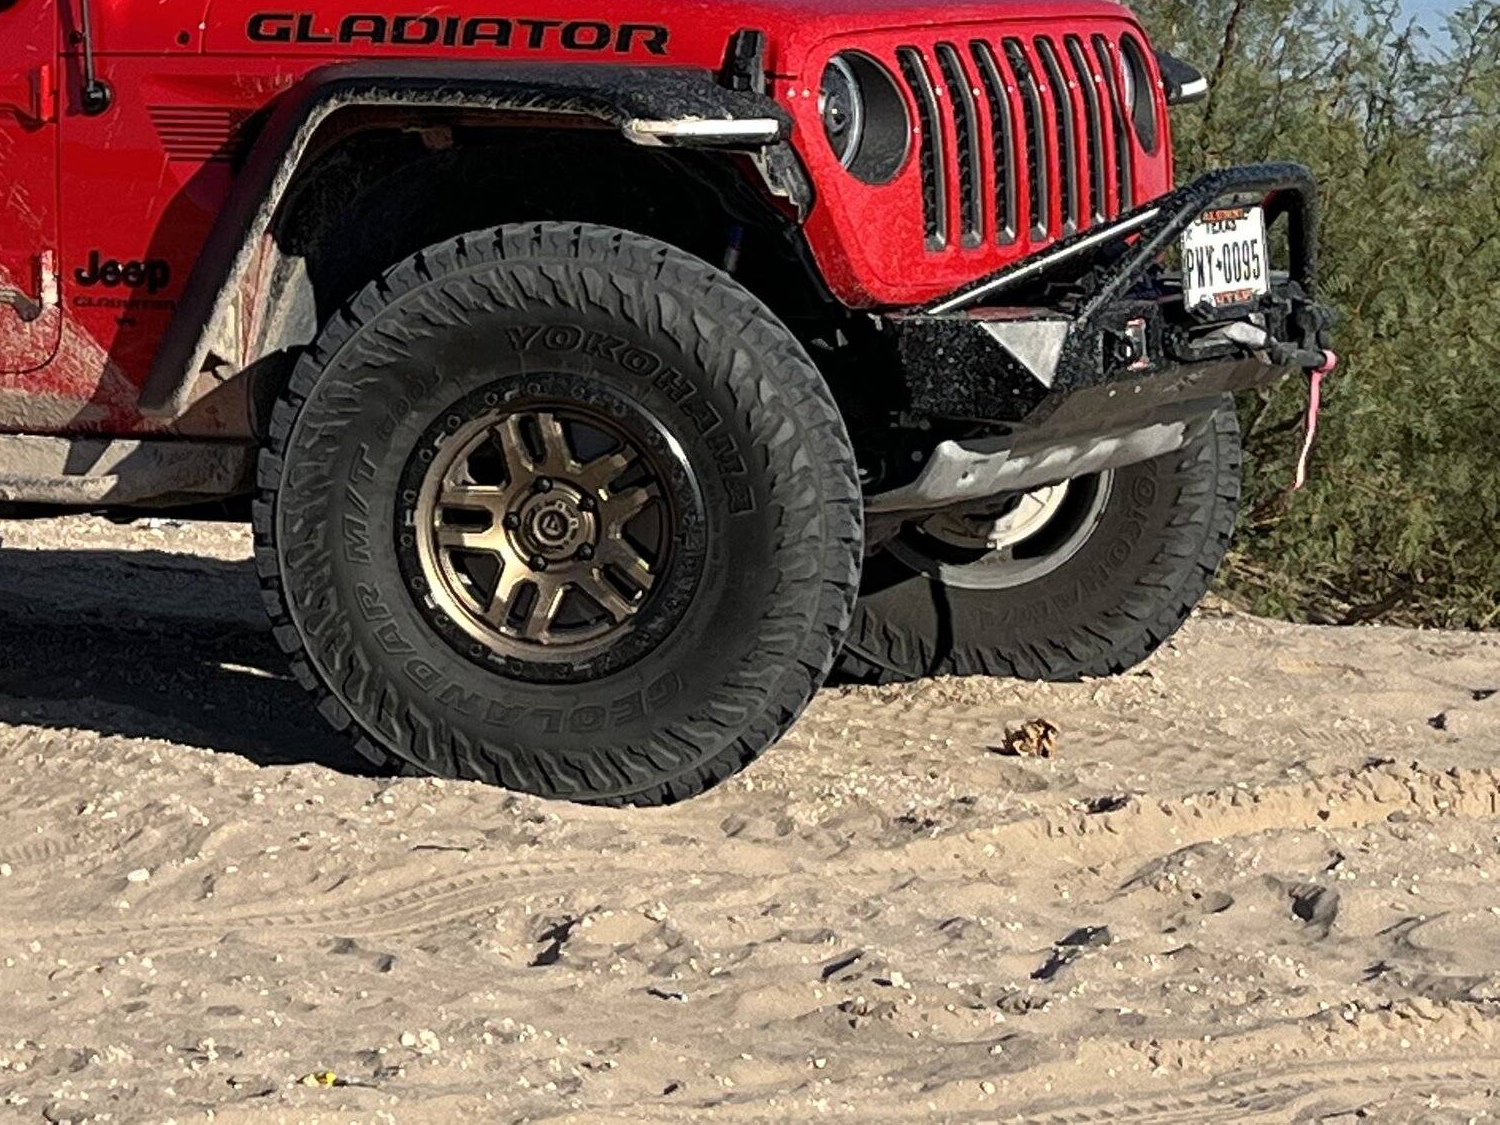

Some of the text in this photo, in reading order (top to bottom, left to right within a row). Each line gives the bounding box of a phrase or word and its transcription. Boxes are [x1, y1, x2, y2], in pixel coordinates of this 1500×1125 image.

[246, 12, 670, 56] GLADIATOR
[74, 249, 170, 294] Jeep
[507, 324, 757, 516] YOKOHAMA
[342, 441, 379, 566] M/T
[359, 579, 687, 736] GEOLANDAR
